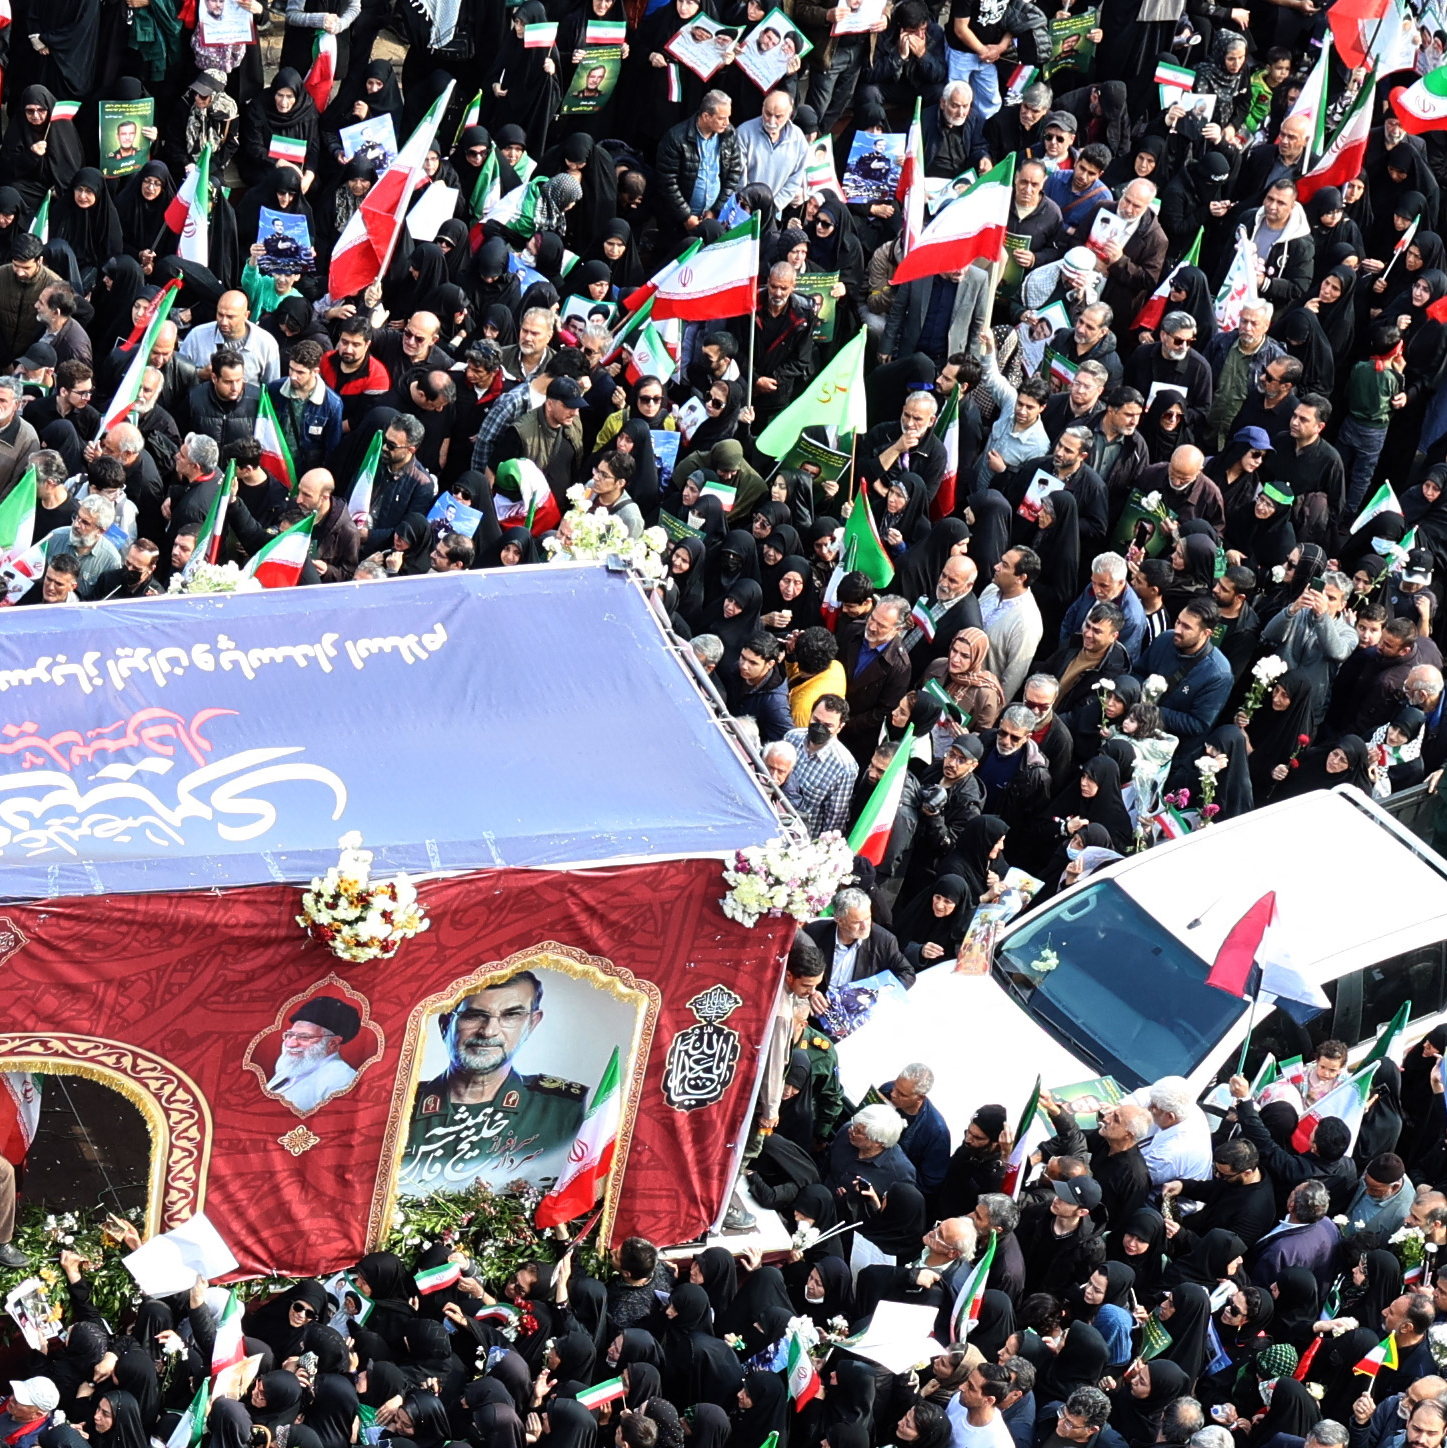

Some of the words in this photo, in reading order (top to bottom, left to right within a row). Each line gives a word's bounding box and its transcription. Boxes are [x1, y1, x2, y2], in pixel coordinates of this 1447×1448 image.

[107, 646, 189, 691] ایران
[191, 643, 215, 672] و
[217, 632, 339, 680] پاسدار
[344, 622, 448, 671] اسلام
